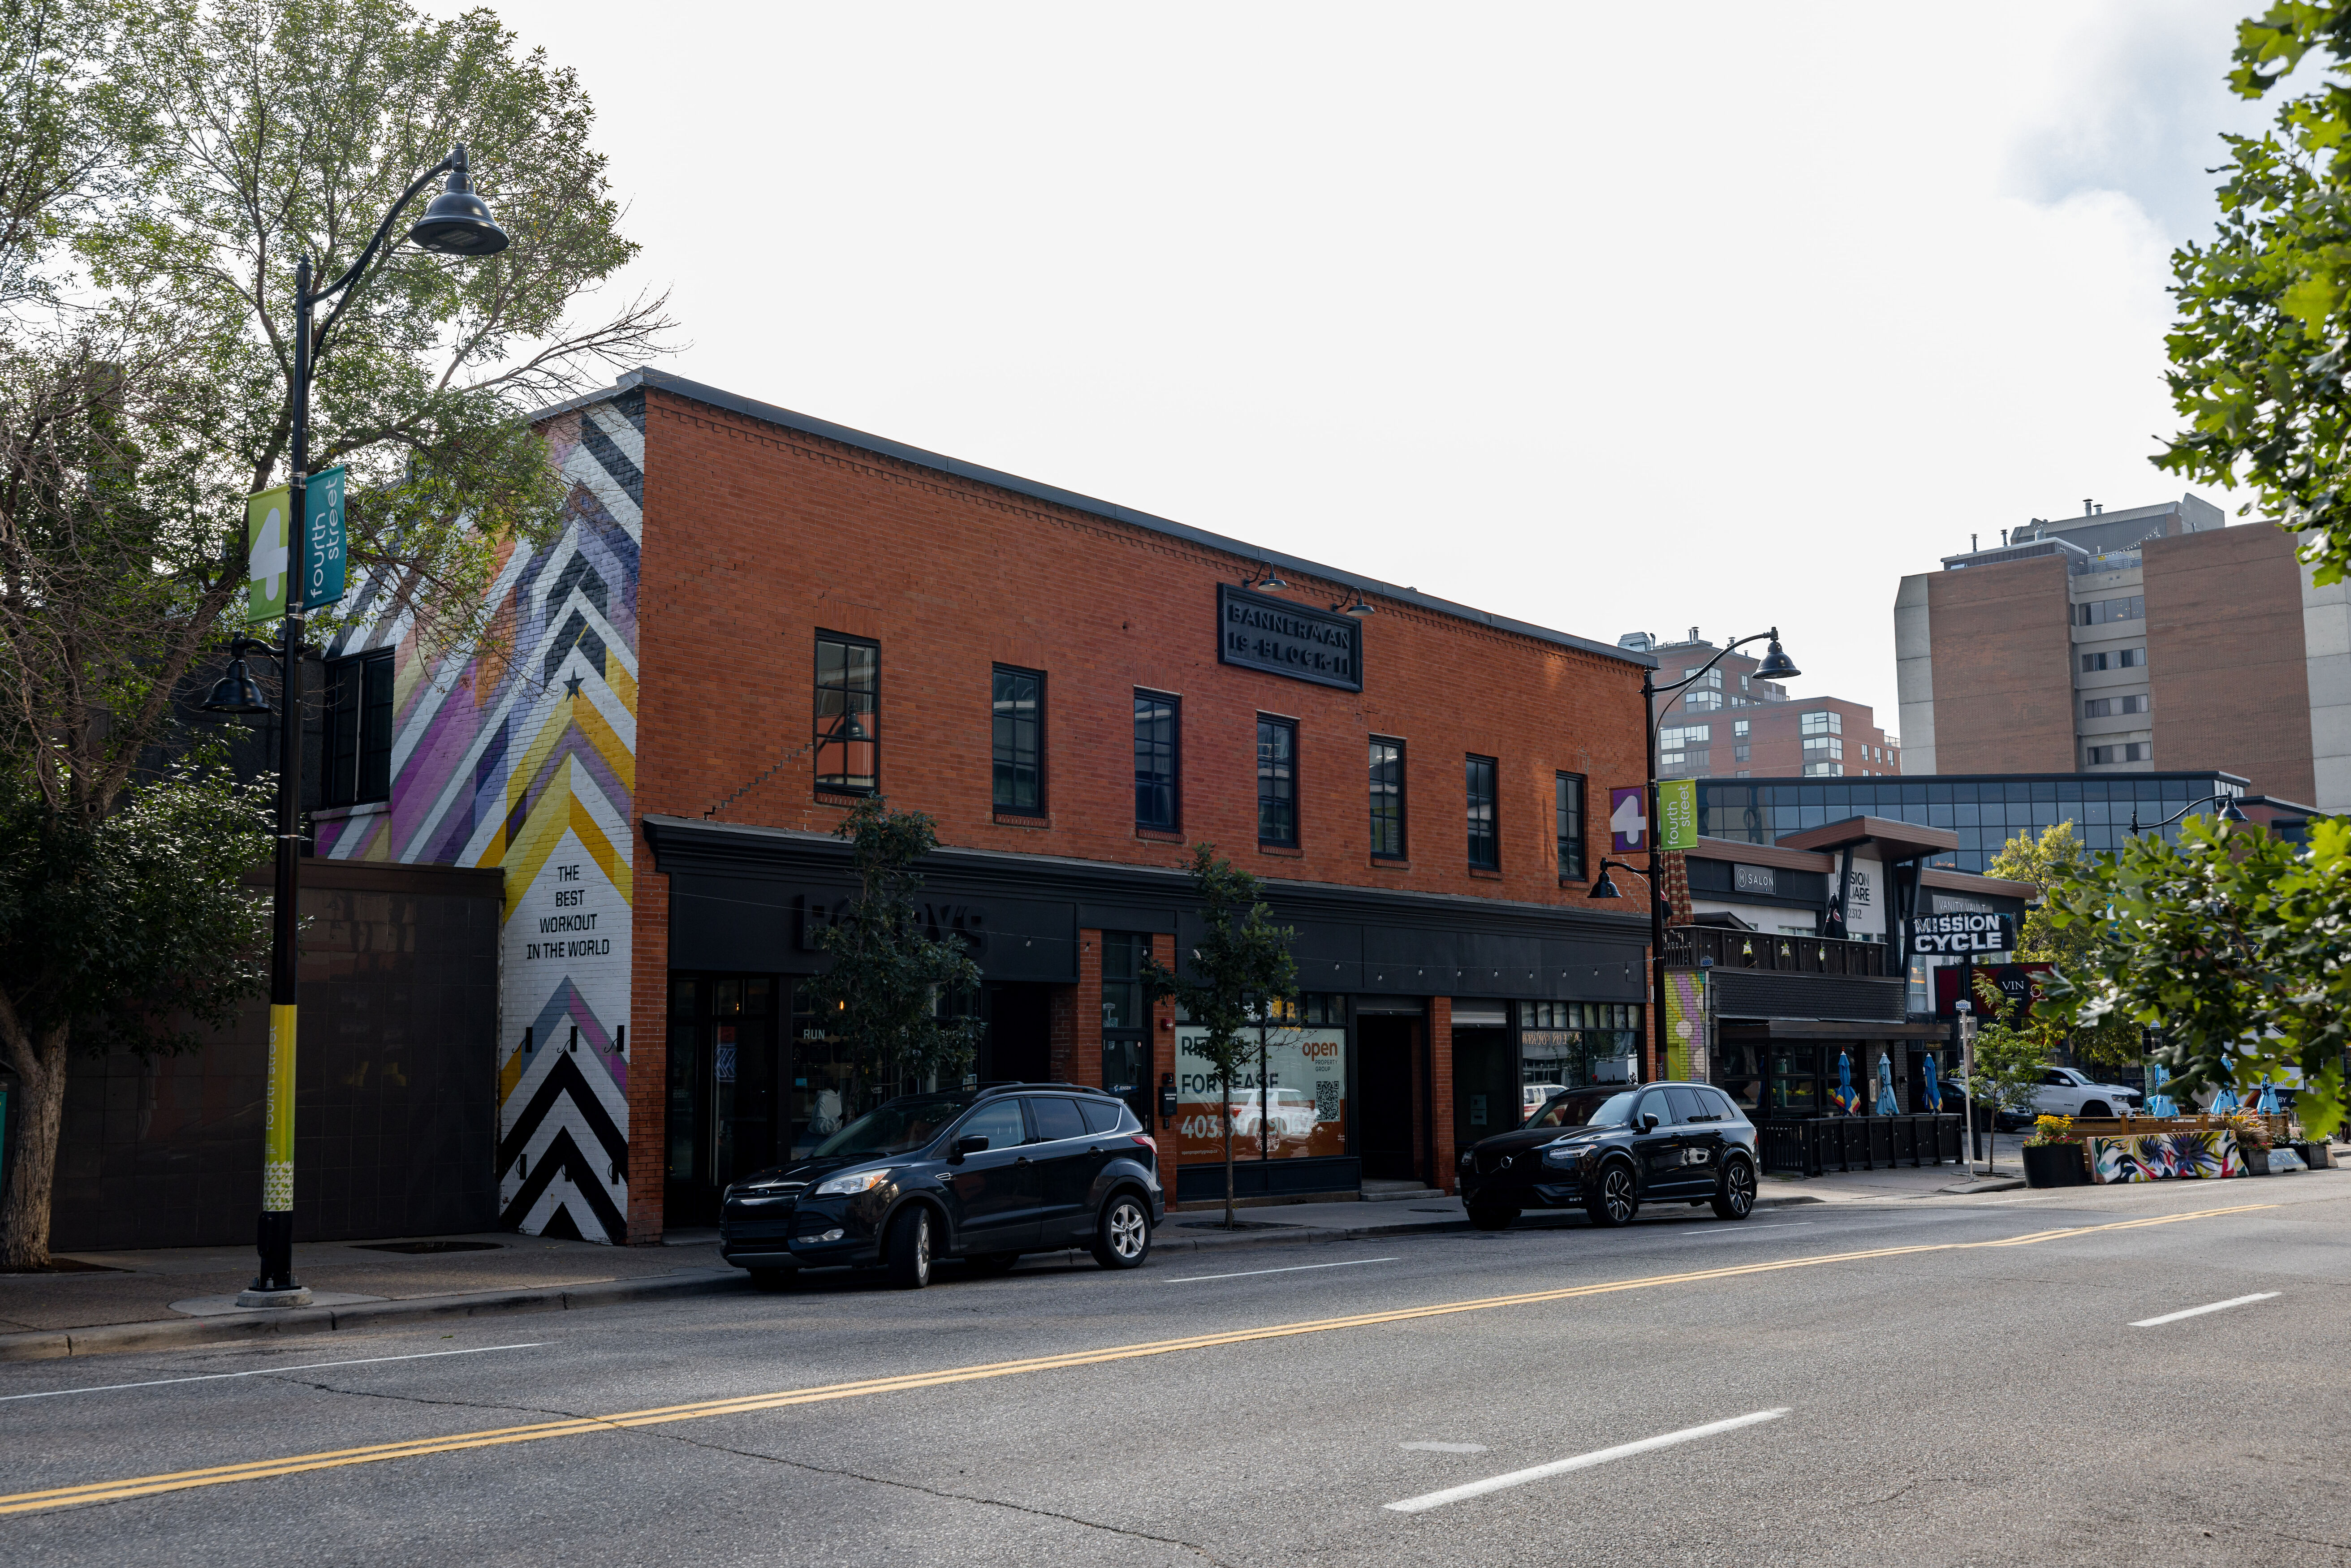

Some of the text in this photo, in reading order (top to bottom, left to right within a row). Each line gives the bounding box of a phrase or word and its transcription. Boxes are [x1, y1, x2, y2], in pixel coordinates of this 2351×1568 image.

[325, 477, 339, 560] street
[310, 512, 326, 599] fourth
[1229, 603, 1350, 649] BANNERMAN
[1678, 784, 1691, 827] street
[1610, 795, 1646, 844] 4
[1666, 801, 1679, 846] fourth
[557, 865, 580, 882] THE
[1748, 874, 1774, 887] SALON
[556, 889, 585, 907] BEST
[1938, 900, 1986, 913] VANITY VAULT
[539, 913, 598, 934] WORKOUT
[1848, 908, 1862, 920] 2312
[1915, 915, 2000, 934] MISSION
[527, 939, 610, 960] IN THE WORLD
[1915, 932, 2003, 952] CYCLE
[2002, 980, 2024, 991] VIN
[803, 1029, 825, 1040] RUN
[1302, 1042, 1338, 1062] open
[266, 1025, 277, 1131] fourth street
[1182, 1074, 1217, 1094] FOR
